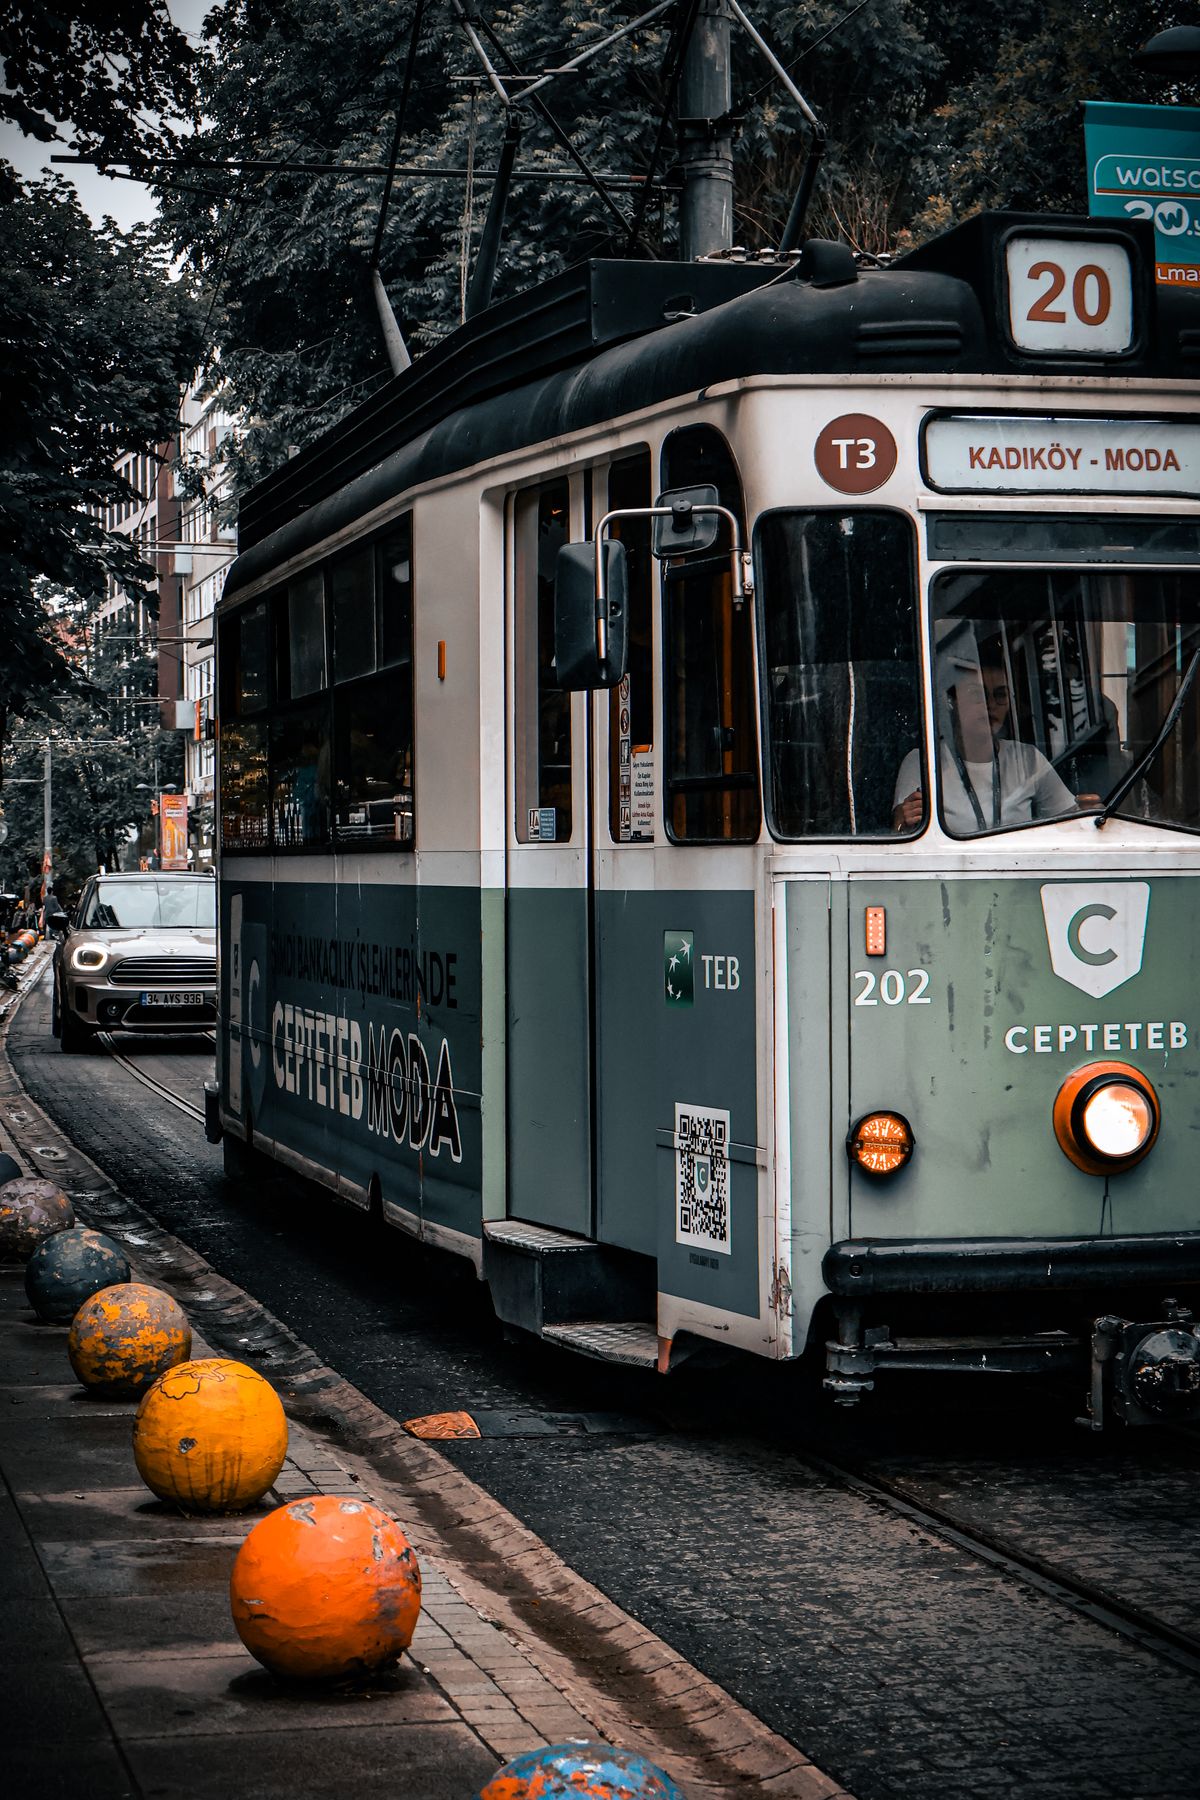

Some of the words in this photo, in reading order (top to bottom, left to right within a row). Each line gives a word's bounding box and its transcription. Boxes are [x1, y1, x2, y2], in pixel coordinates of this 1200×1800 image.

[1026, 261, 1111, 326] 20
[831, 438, 876, 469] T3
[969, 443, 1081, 470] KADIKÖY
[1105, 448, 1181, 471] MODA
[356, 927, 458, 1009] İŞLEMLERİNDE
[701, 955, 740, 990] TEB
[148, 993, 159, 1004] 34
[163, 993, 181, 1004] AYS
[183, 993, 201, 1004] 936
[854, 969, 931, 1006] 202
[1005, 1022, 1188, 1054] CEPTETEB
[272, 1000, 362, 1120] CEPTETEB
[368, 1021, 463, 1164] MODA
